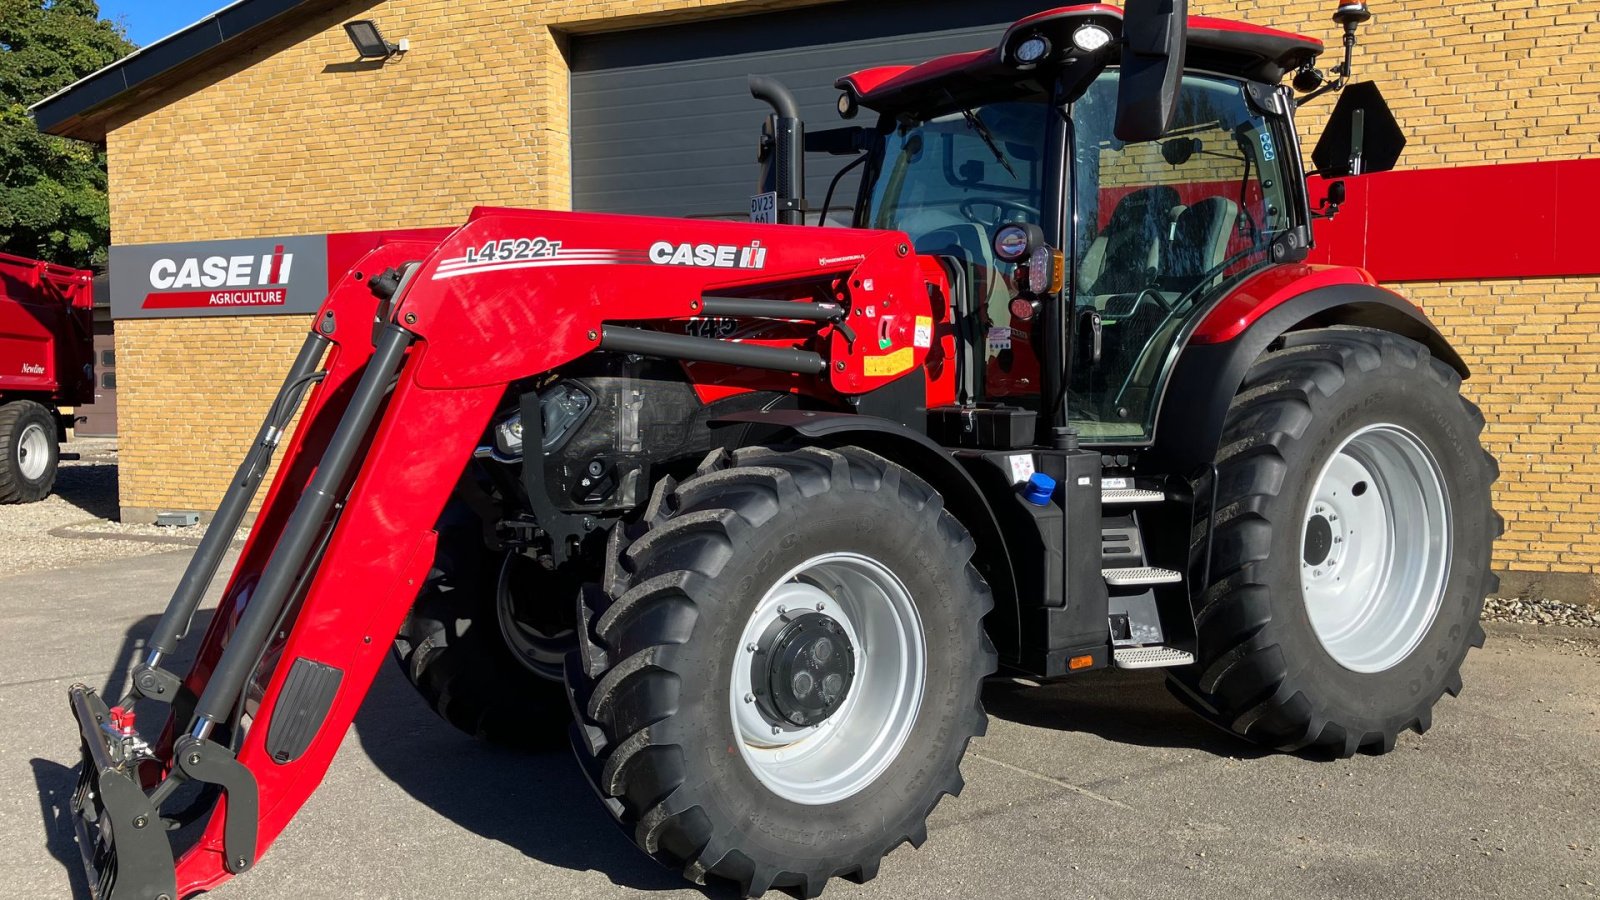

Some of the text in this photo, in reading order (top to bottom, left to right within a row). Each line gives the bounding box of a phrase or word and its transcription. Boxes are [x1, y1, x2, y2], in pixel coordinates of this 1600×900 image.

[751, 195, 774, 212] DV23
[648, 241, 738, 268] CASE
[149, 255, 255, 290] CASE
[209, 291, 282, 305] AGRICULTURE
[685, 317, 738, 339] 145
